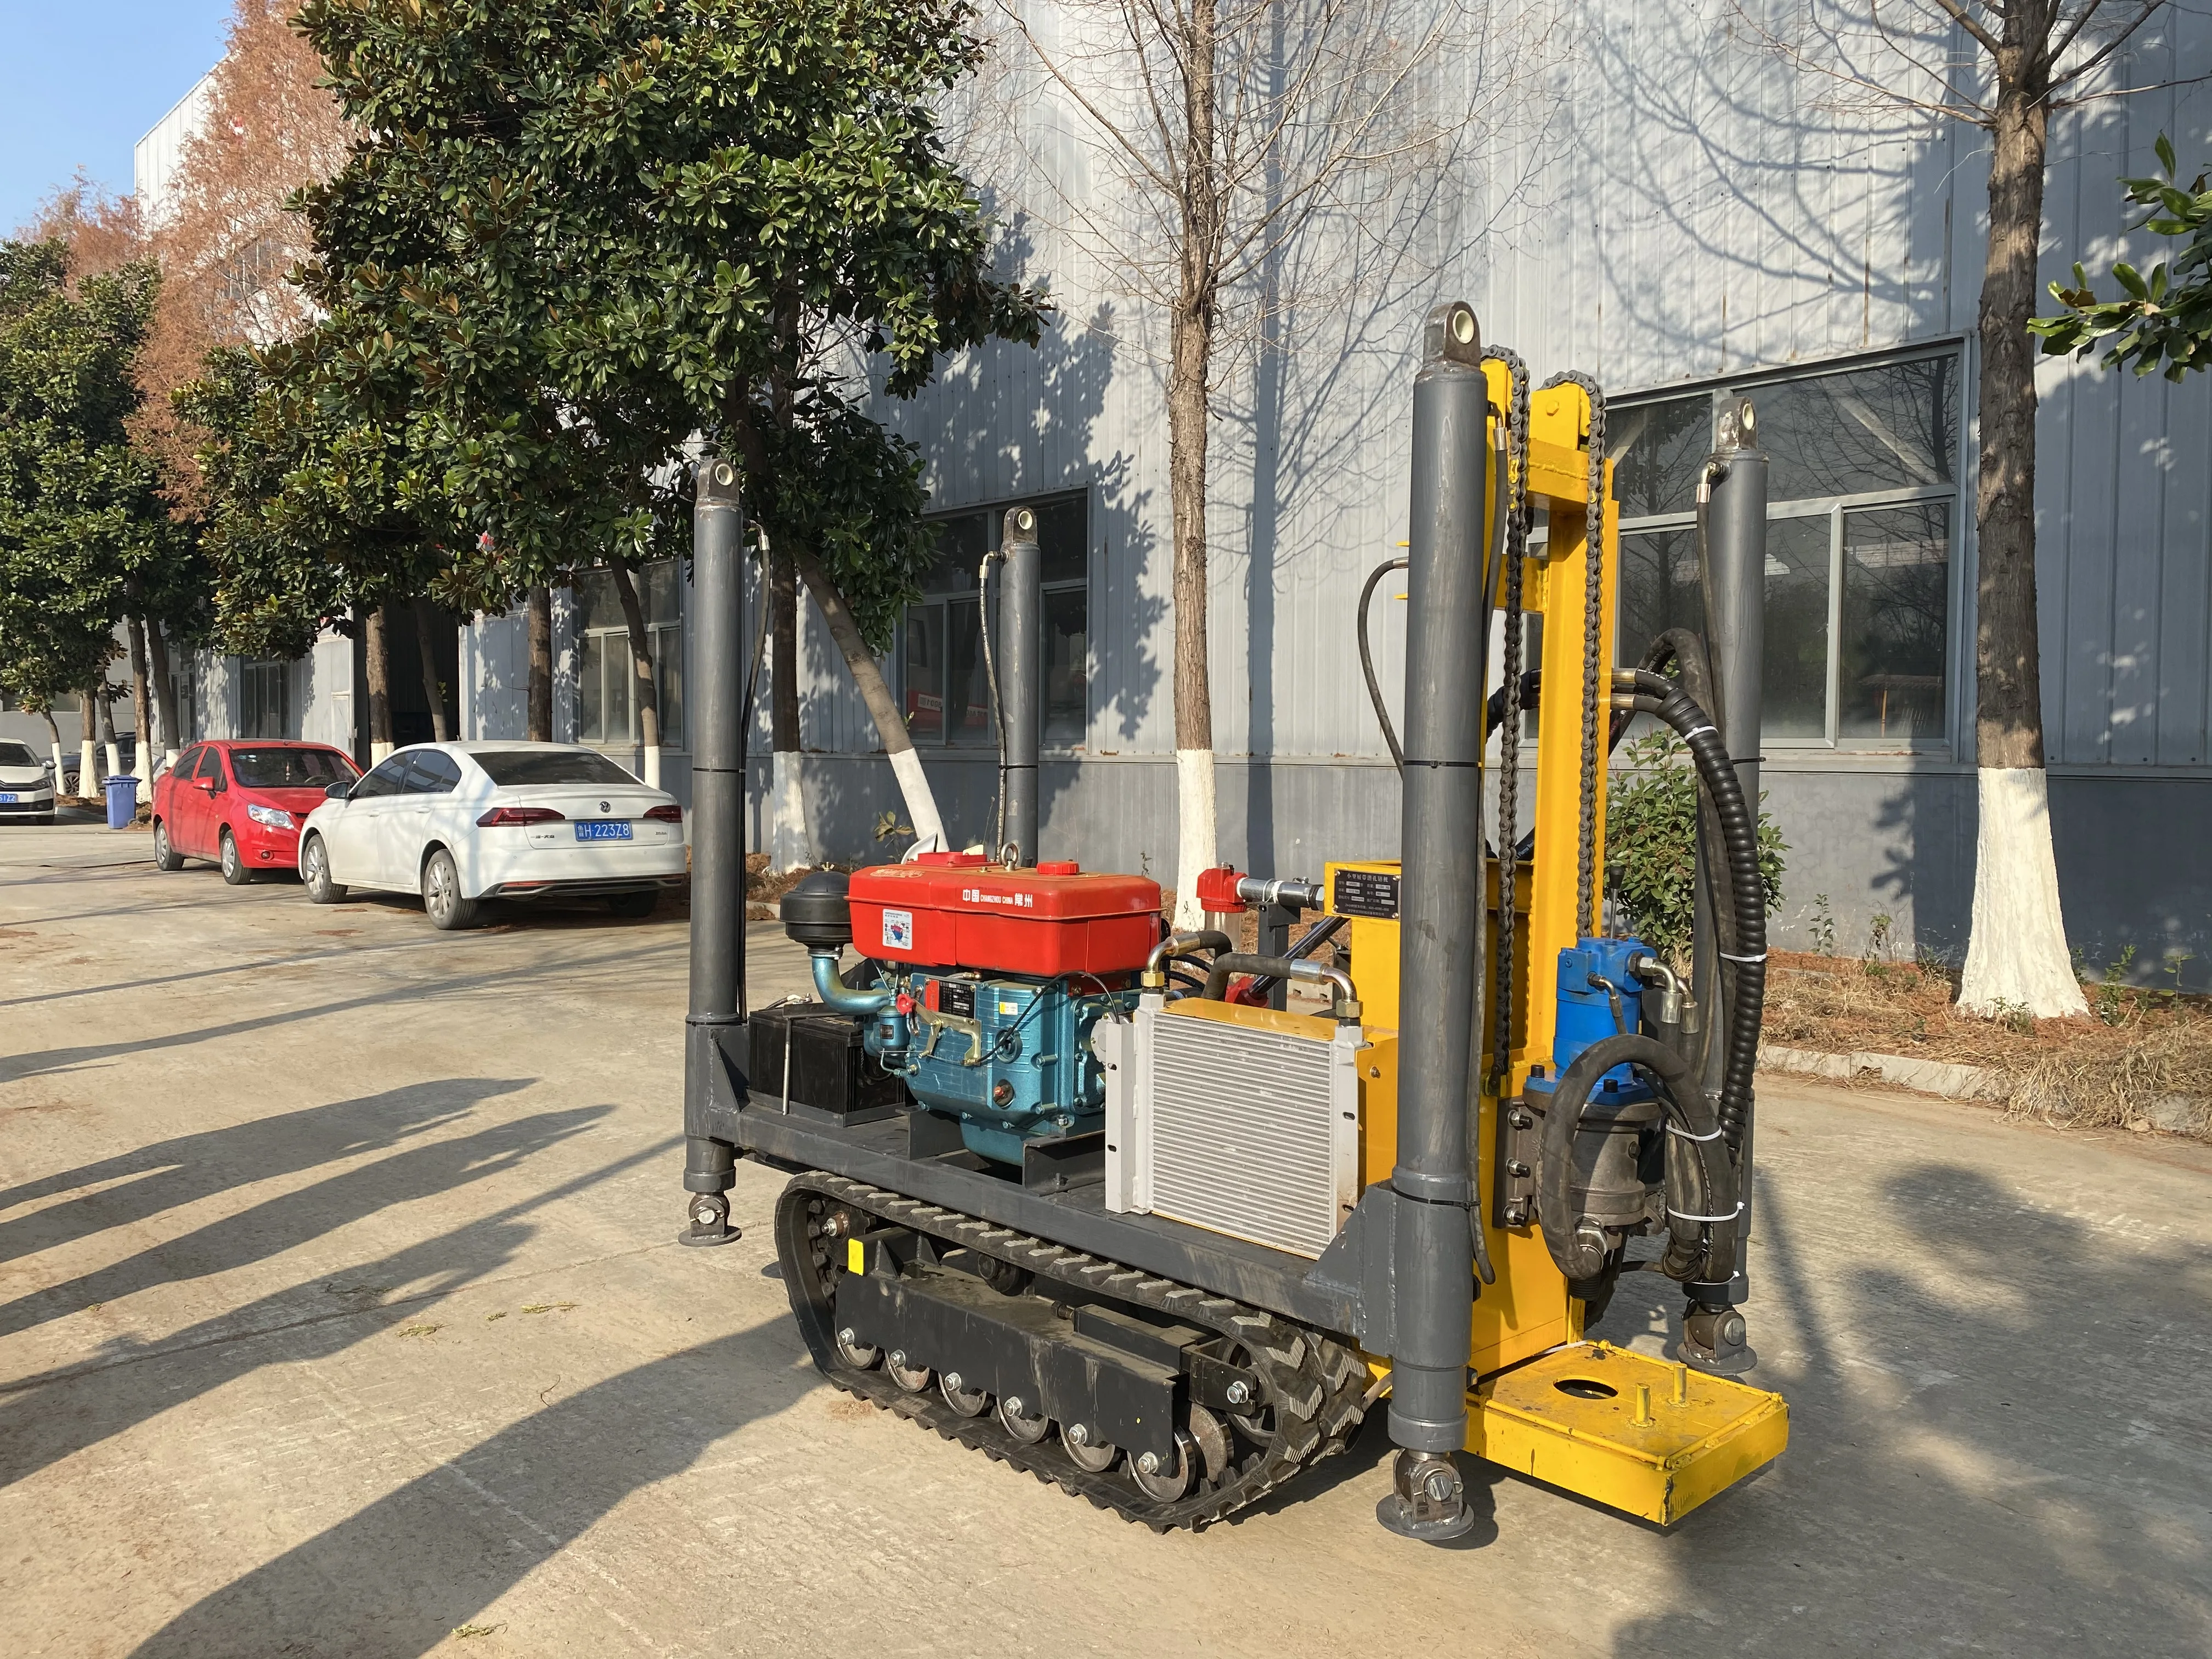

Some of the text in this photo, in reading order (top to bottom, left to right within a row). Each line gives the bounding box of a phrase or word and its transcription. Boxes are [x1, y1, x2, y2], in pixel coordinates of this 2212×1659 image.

[962, 889, 1032, 908] 中国 CHANGZHOU CHINA 常州
